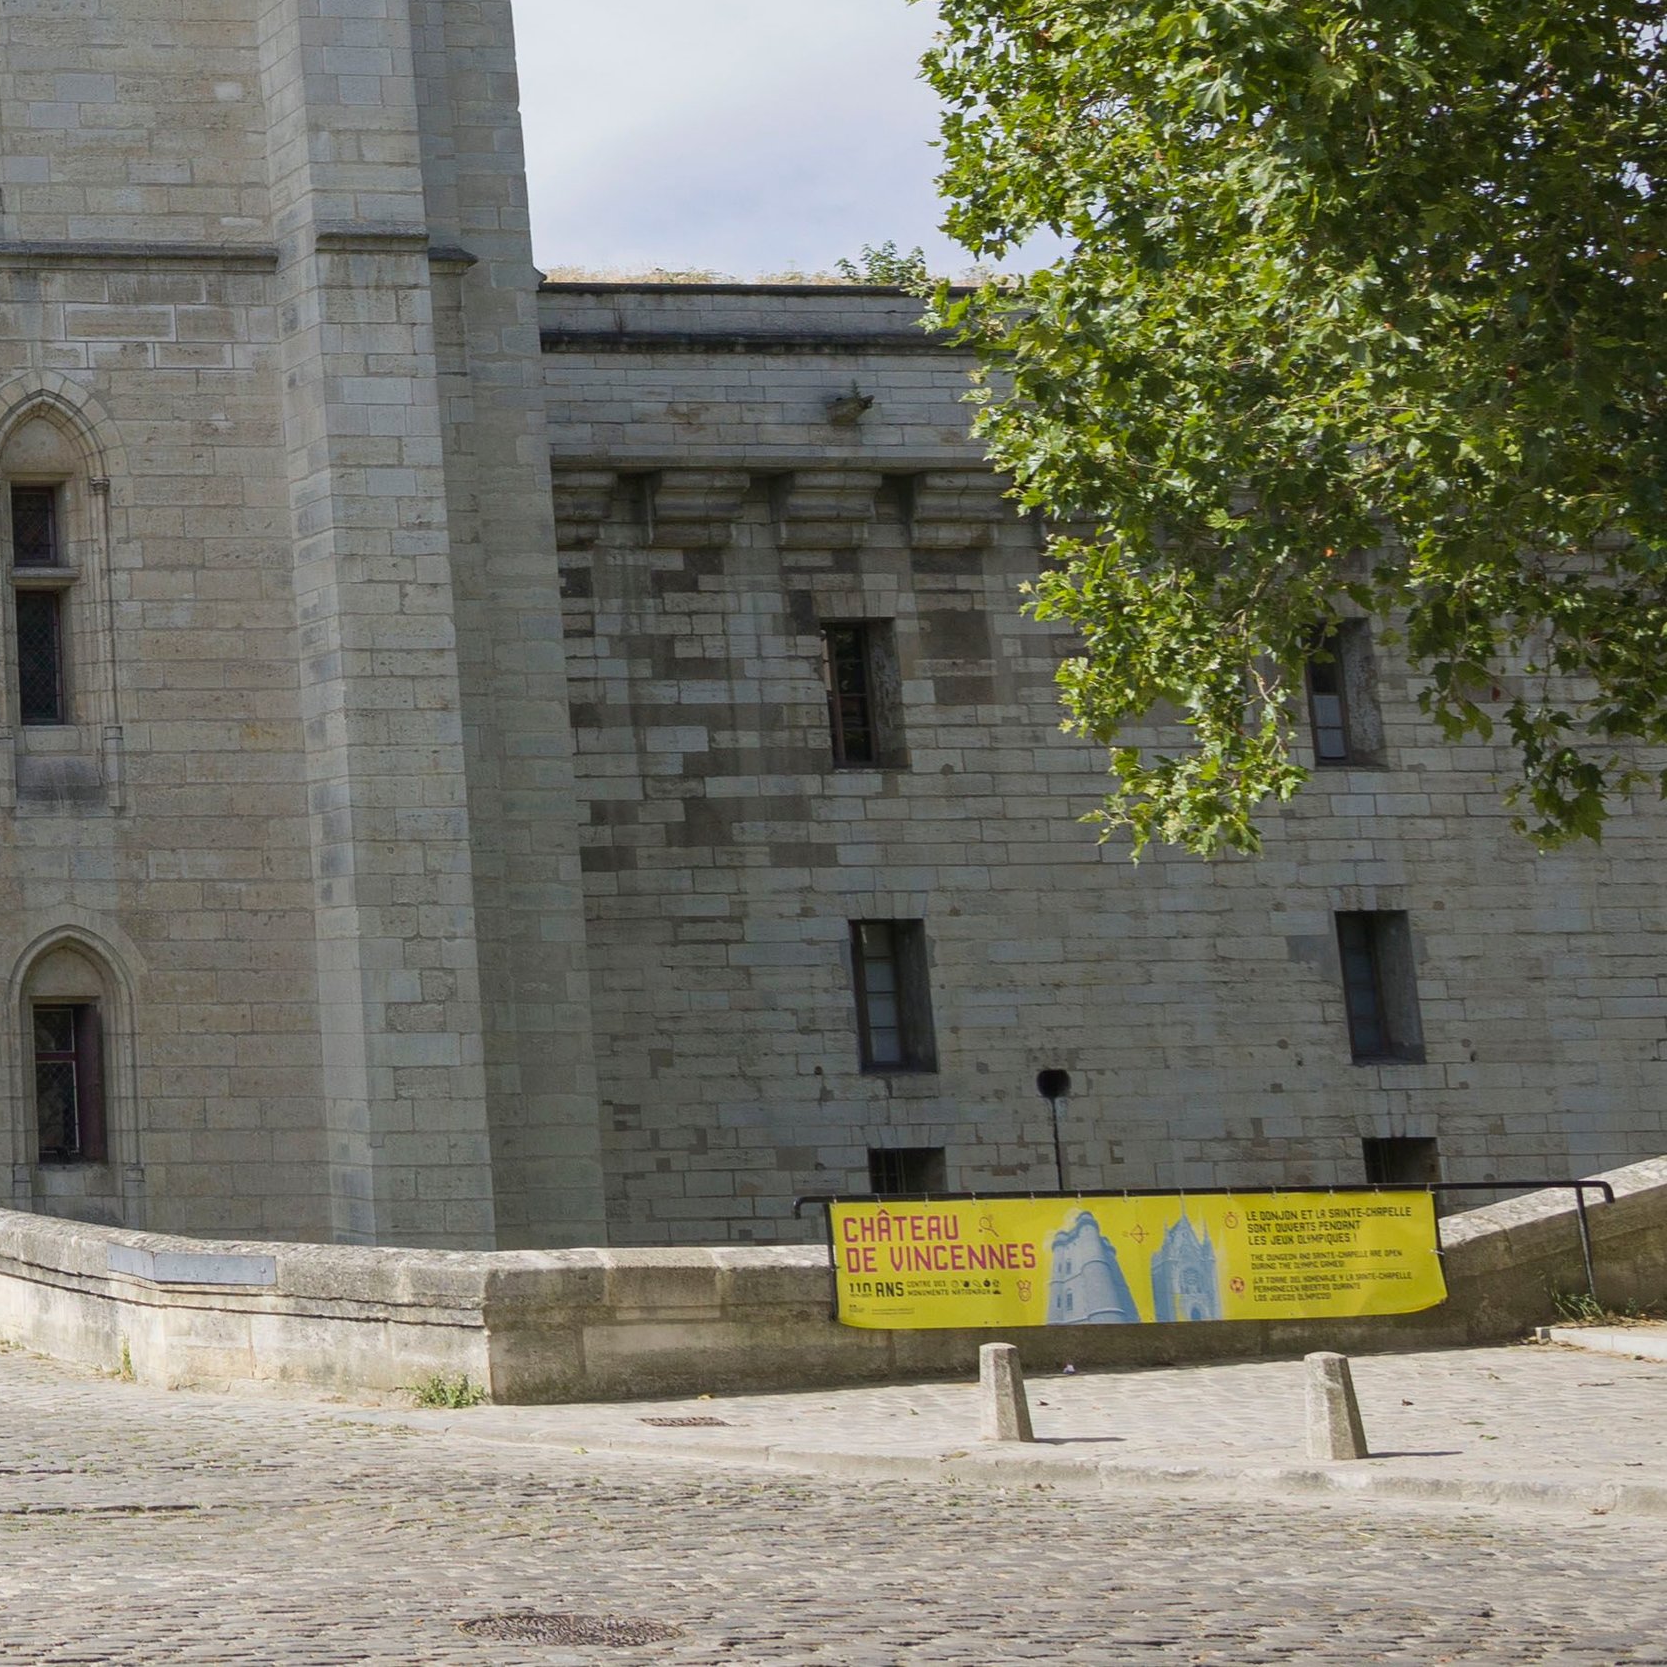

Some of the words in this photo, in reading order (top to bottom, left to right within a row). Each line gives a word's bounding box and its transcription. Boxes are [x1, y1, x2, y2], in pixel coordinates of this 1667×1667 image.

[1246, 1211, 1257, 1221] LE
[1260, 1210, 1298, 1221] DONJON
[1301, 1209, 1313, 1219] ET
[1317, 1209, 1326, 1219] LA
[1329, 1206, 1412, 1218] SAINTE-CHAPELLE
[843, 1209, 960, 1243] CHÂTEAU
[1247, 1223, 1272, 1233] SONT
[1275, 1221, 1316, 1233] OUVERTS
[1319, 1220, 1361, 1231] PENDANT
[1248, 1235, 1267, 1246] LES
[1270, 1234, 1295, 1245] JEUX
[1297, 1232, 1350, 1246] OLYMPIQUES
[846, 1246, 878, 1273] DE
[889, 1243, 1037, 1272] VINCENNES
[1251, 1253, 1264, 1261] THE
[875, 1281, 904, 1298] ANS
